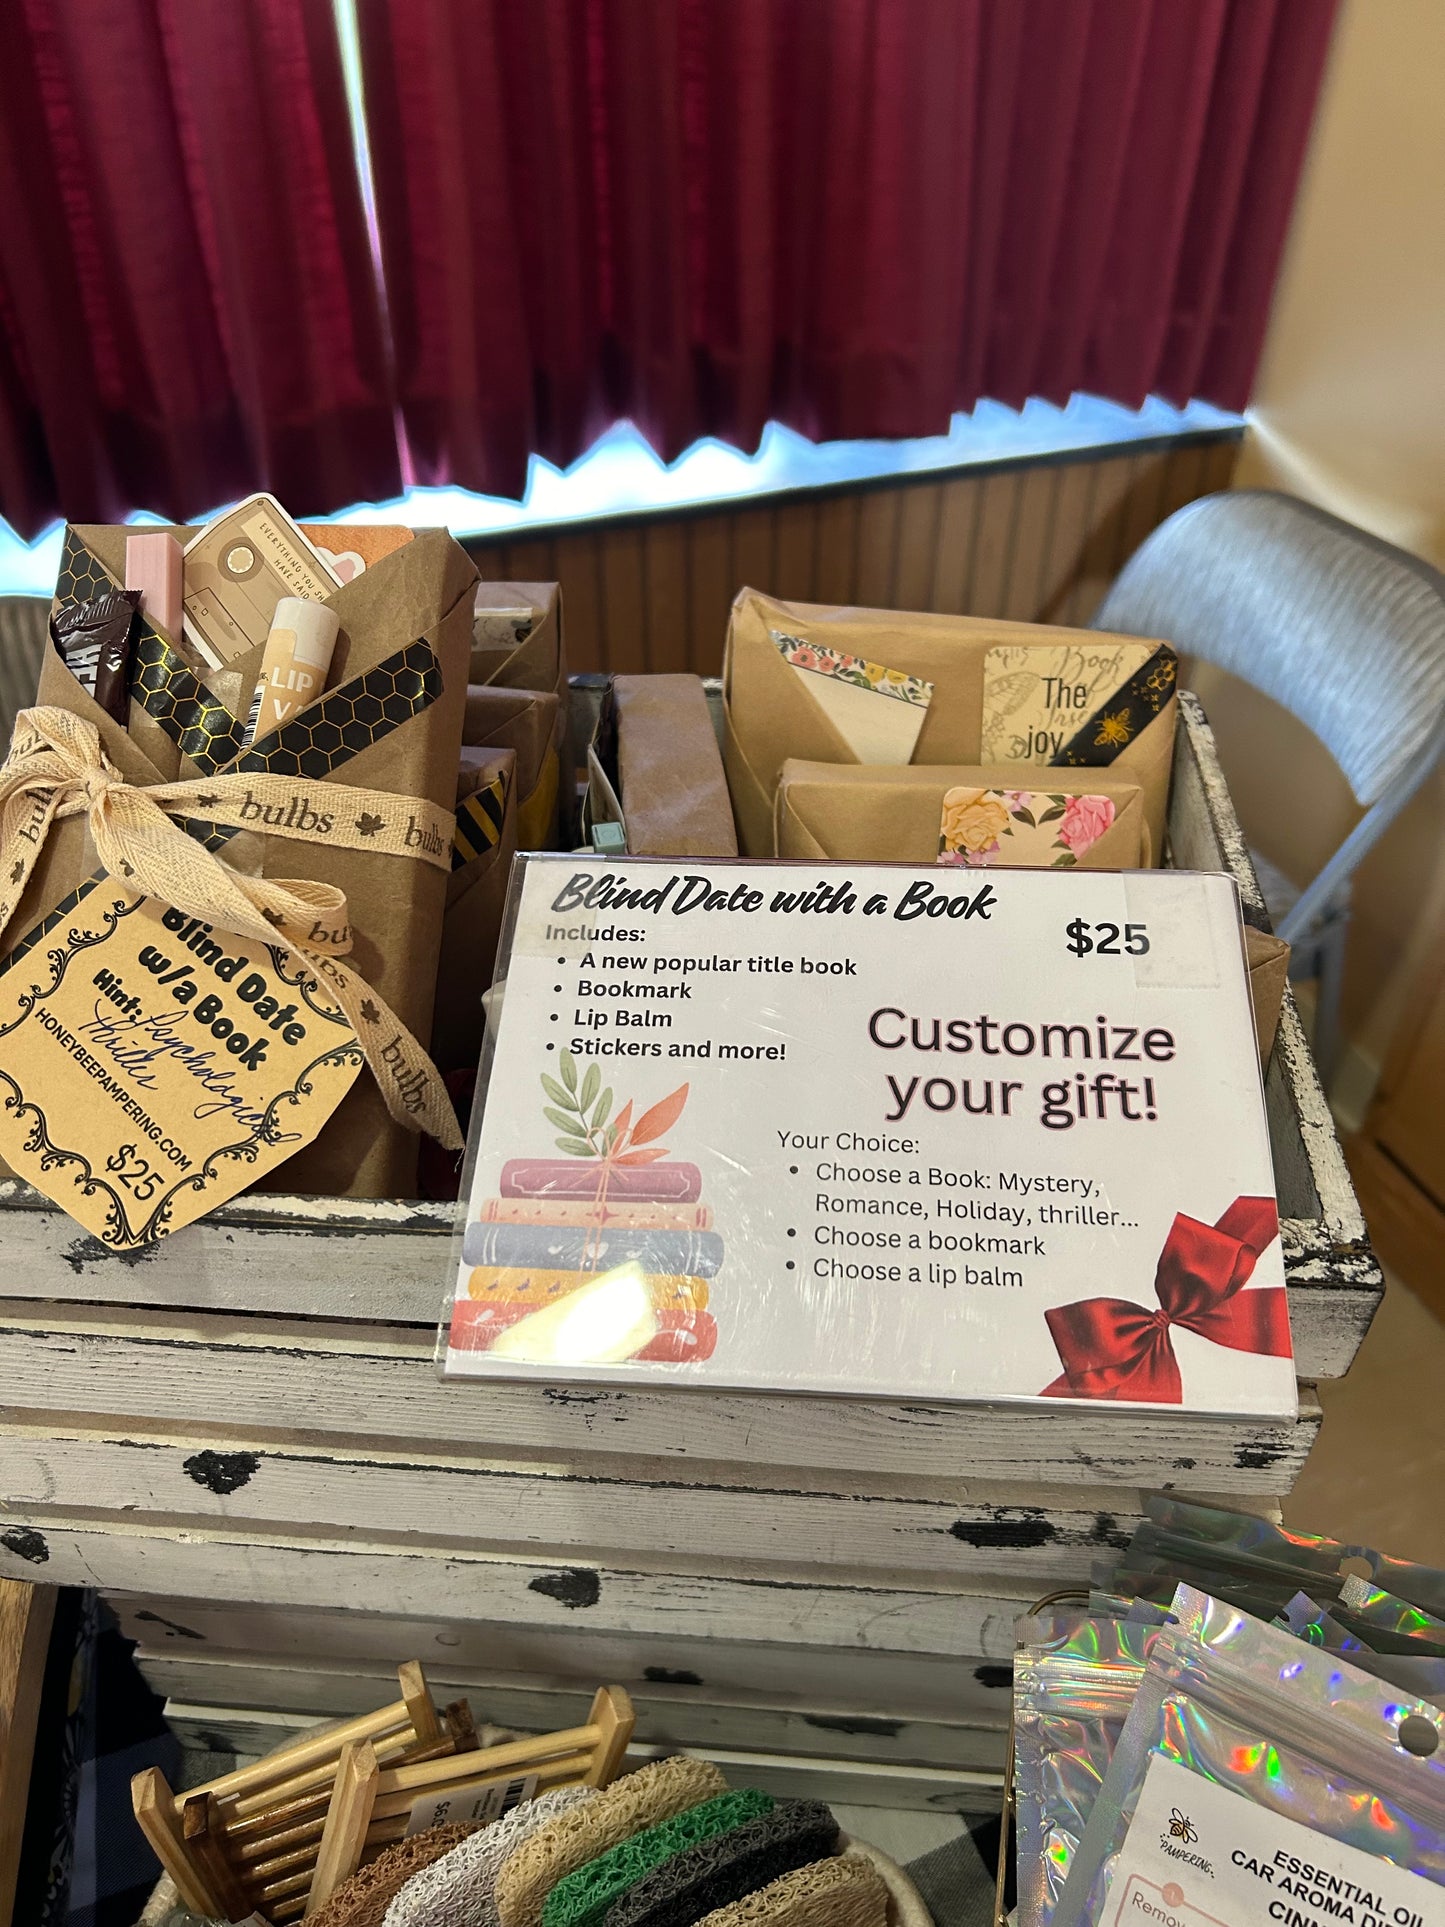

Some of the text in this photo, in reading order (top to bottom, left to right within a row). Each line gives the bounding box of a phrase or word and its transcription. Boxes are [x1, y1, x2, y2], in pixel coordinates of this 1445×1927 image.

[259, 522, 302, 573] EVERYTHING
[301, 573, 315, 589] YOU
[274, 559, 310, 600] HAVE SAID
[270, 666, 314, 692] LIP
[1041, 677, 1087, 709] The
[1023, 724, 1064, 759] joy
[239, 790, 445, 857] bulbs bulbs
[551, 874, 997, 921] Blind Date with a Book
[546, 925, 645, 941] Includes:
[1066, 918, 1150, 958] $25
[161, 906, 249, 983] Blind
[236, 972, 307, 1046] Date
[580, 953, 857, 975] A new popular title book
[92, 968, 144, 1023] Hint:
[138, 945, 271, 1072] w/a Book
[578, 980, 692, 998] Bookmark
[574, 1009, 672, 1030] Lip Balm
[868, 1008, 1176, 1062] Customize
[570, 1038, 785, 1060] Stickers and more!
[34, 1007, 193, 1172] HONEYBEEPAMPERING.COM
[381, 1034, 430, 1114] bulbs
[885, 1073, 1157, 1130] your gift!
[777, 1131, 919, 1153] Your Choice:
[105, 1143, 165, 1201] $25
[817, 1163, 1099, 1198] Choose a Book: Mystery,
[816, 1194, 1138, 1227] Romance, Holiday, thriller...
[815, 1226, 1045, 1255] Choose a bookmark
[814, 1258, 1022, 1288] Choose a lip balm
[1160, 1840, 1212, 1873] PAMPERING
[1231, 1850, 1354, 1924] CAR AROMA
[1273, 1850, 1386, 1916] ESSENTIAL
